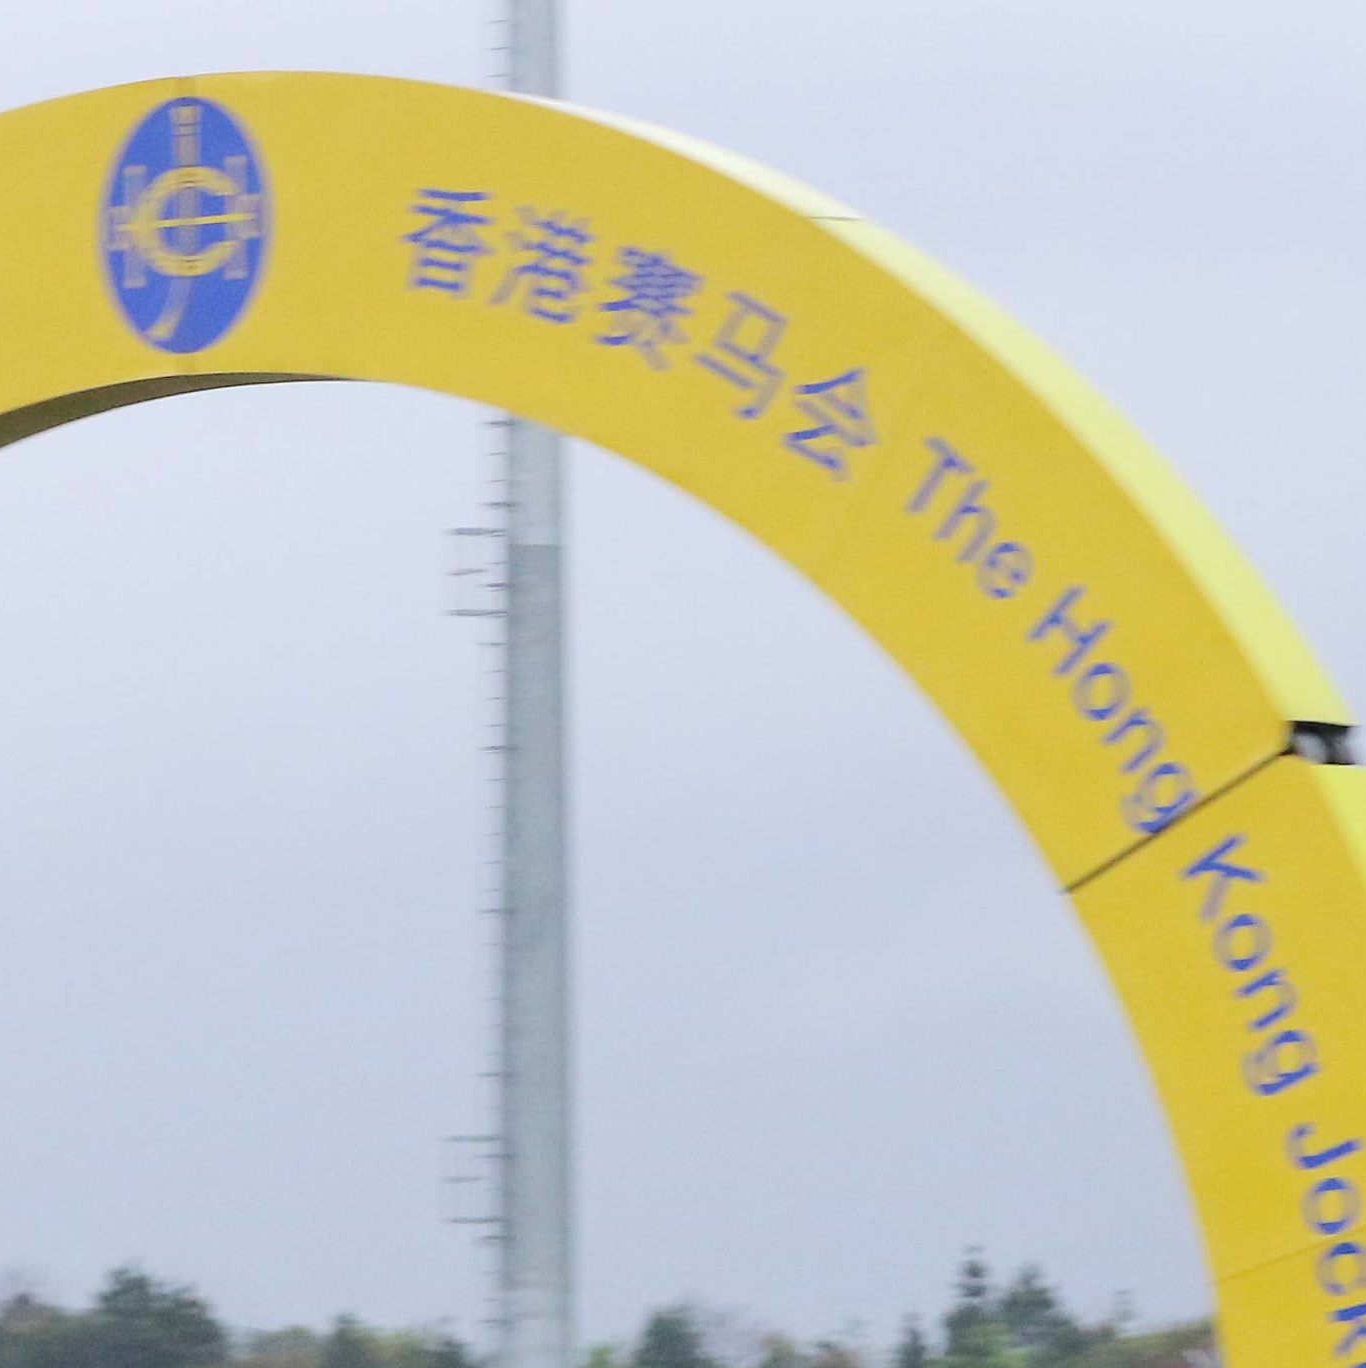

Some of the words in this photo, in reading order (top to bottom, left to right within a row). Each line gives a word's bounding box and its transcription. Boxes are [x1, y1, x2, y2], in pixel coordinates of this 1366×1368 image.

[399, 188, 881, 482] 香港赛马会
[903, 435, 1036, 600] The
[1024, 583, 1202, 836] Hong
[1178, 833, 1321, 1097] Kong
